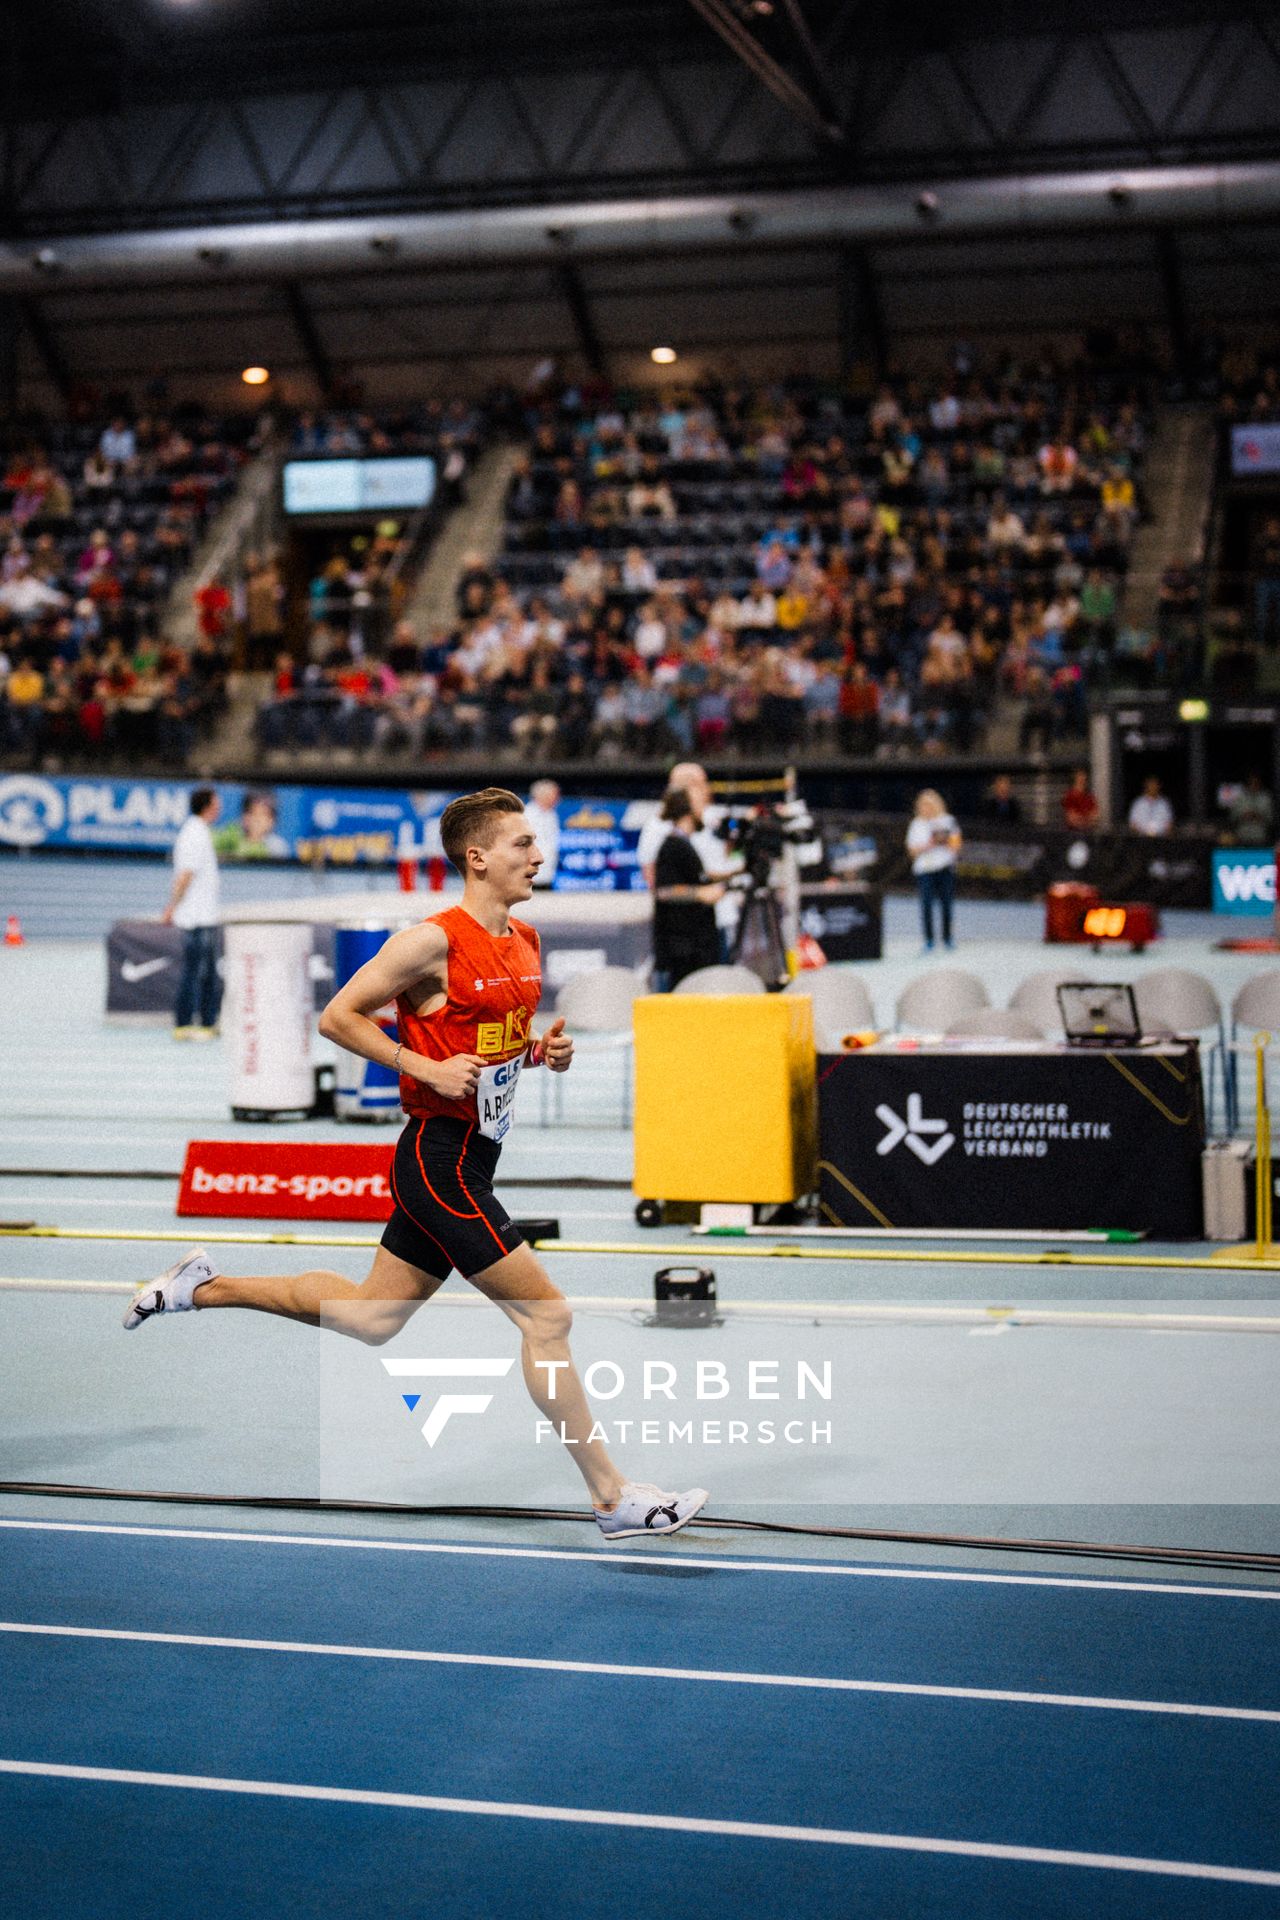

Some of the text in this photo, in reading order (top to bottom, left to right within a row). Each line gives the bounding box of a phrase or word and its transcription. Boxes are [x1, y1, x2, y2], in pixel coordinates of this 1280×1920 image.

[962, 1102, 1069, 1121] DEUTSCHER
[962, 1121, 1112, 1140] LEICHTATHLETIK
[962, 1139, 1049, 1158] VERBAND
